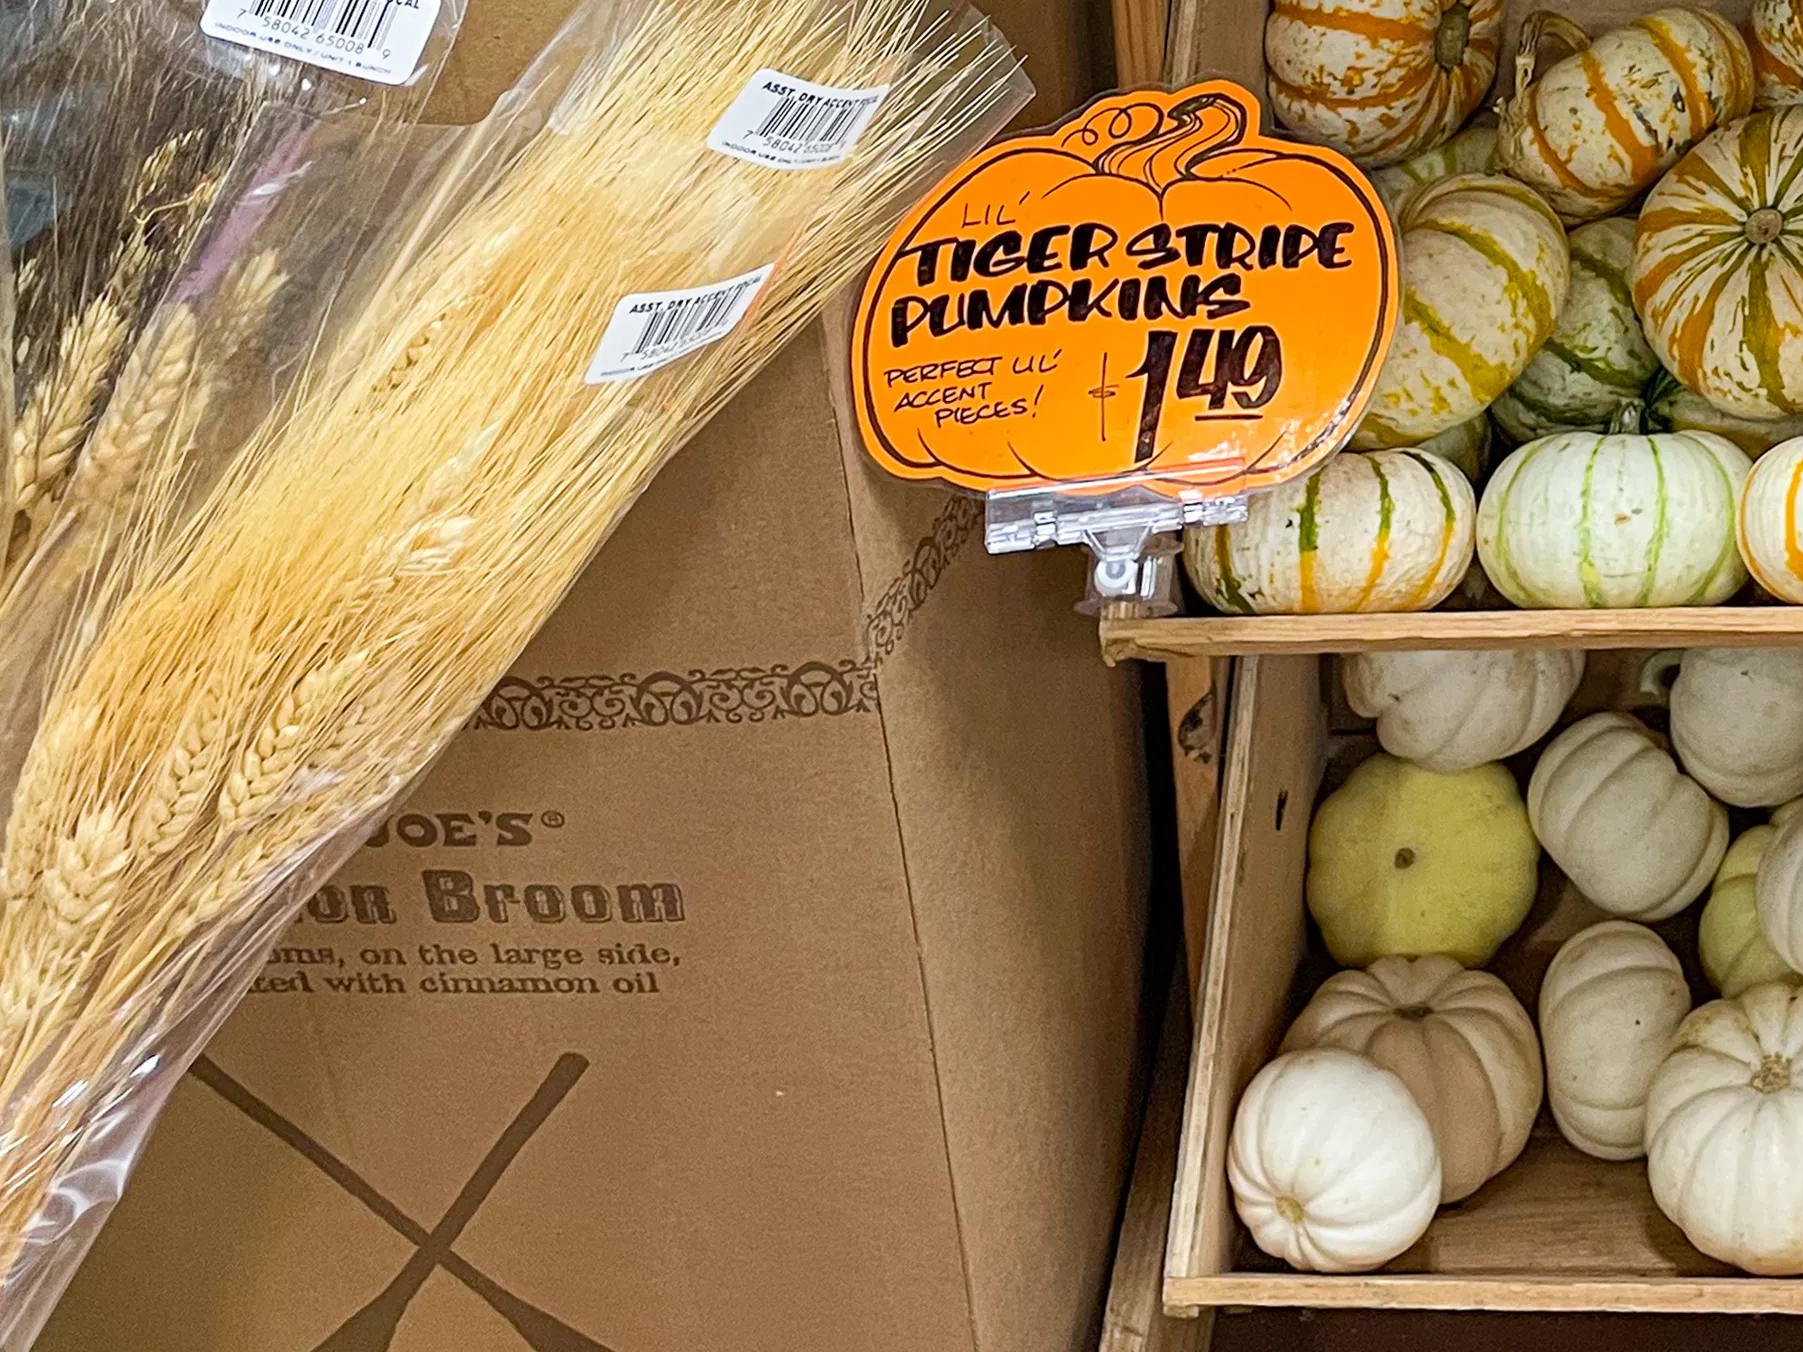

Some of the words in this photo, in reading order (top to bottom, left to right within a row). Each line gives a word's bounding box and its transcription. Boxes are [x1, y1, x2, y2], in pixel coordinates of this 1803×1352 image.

[236, 8, 247, 19] 7
[262, 16, 310, 40] 58042
[316, 33, 364, 55] 65008
[381, 48, 392, 60] 9
[798, 92, 824, 106] DRY
[961, 191, 1031, 229] LIL'
[897, 222, 1119, 288] TIGER
[1125, 222, 1354, 271] STRIPE
[891, 273, 1250, 348] PUMPKINS
[883, 354, 1004, 390] PERFECT
[892, 382, 993, 412] ACCENT
[934, 384, 1045, 429] PIECES!
[294, 884, 398, 924] on
[421, 869, 686, 924] Broom
[360, 948, 407, 966] on
[418, 943, 478, 965] the
[492, 943, 584, 970] large
[597, 943, 681, 968] side,
[323, 971, 407, 994] with
[419, 971, 600, 995] cinnamon
[612, 971, 660, 995] oil
